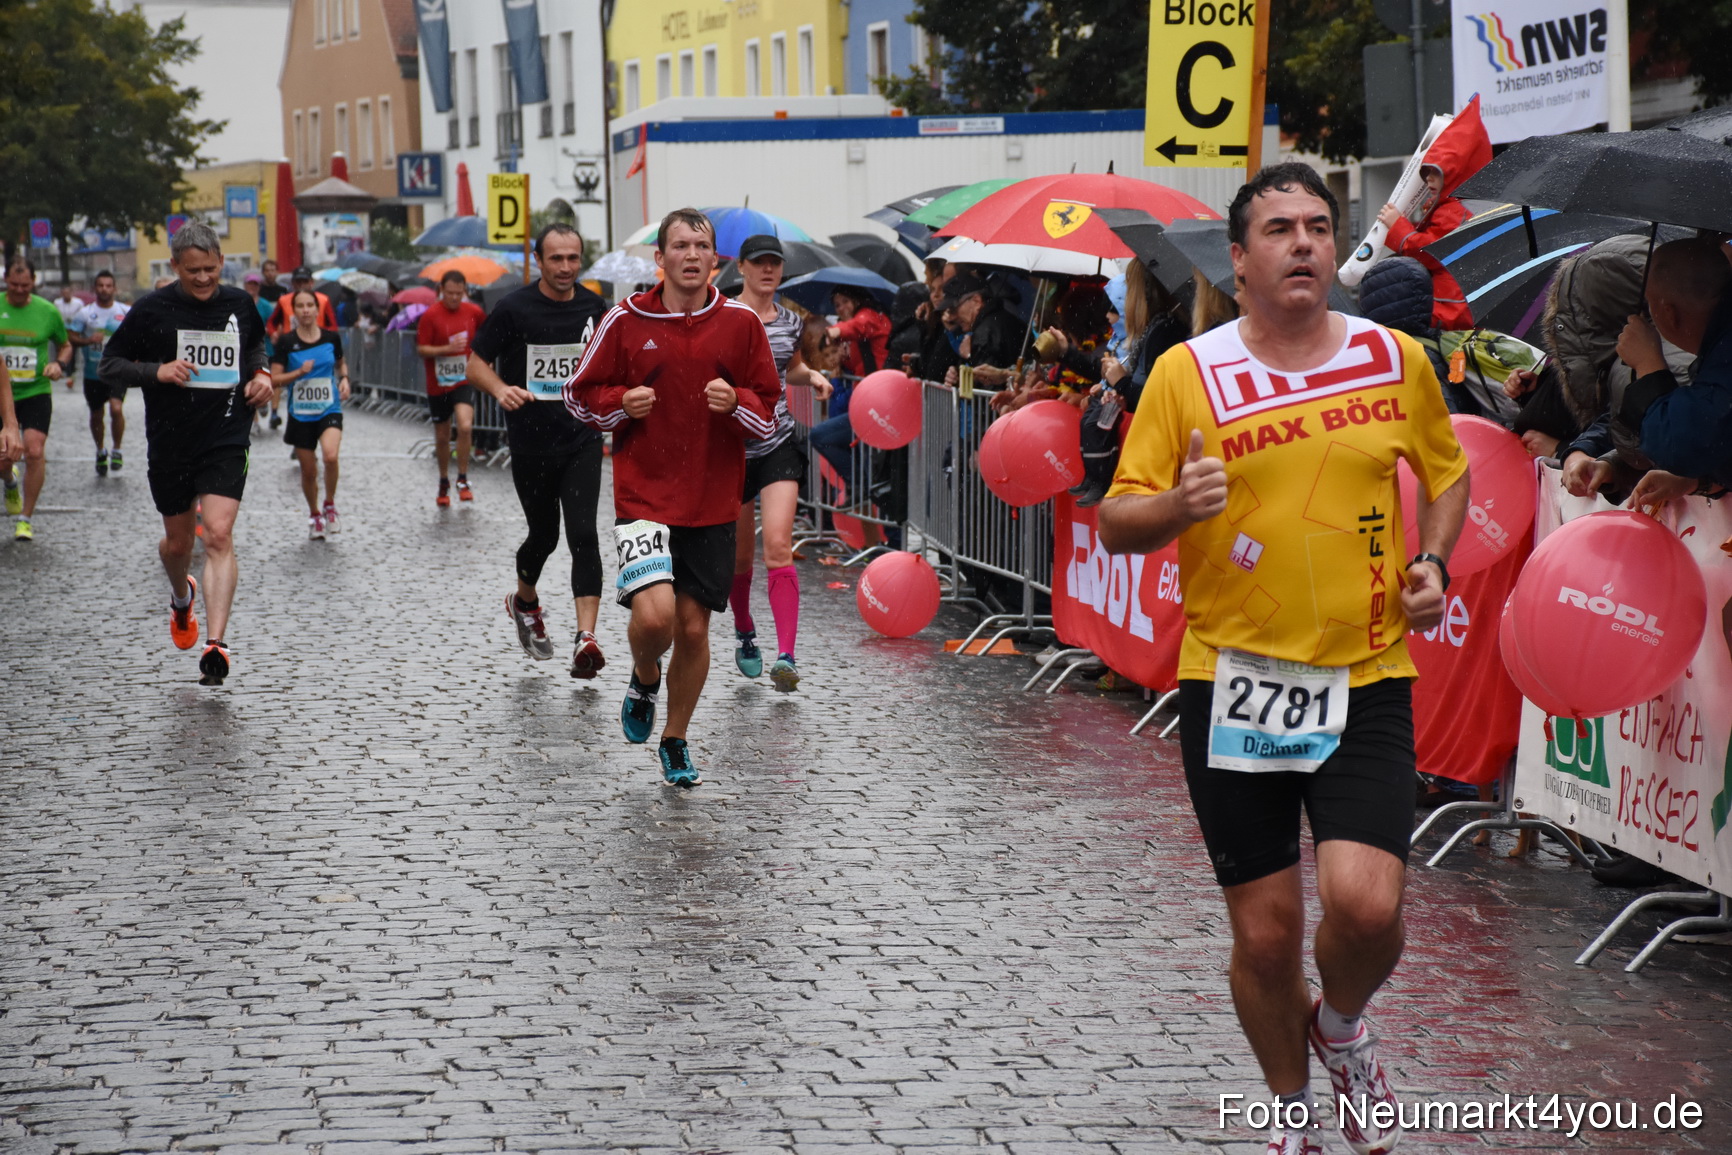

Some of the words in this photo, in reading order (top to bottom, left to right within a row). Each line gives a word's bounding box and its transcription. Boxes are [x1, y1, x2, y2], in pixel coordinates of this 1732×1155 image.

[1164, 0, 1254, 26] Block
[1176, 40, 1236, 129] C
[492, 175, 525, 189] Block
[499, 195, 518, 228] D
[183, 345, 235, 367] 3009
[438, 363, 465, 376] 2649
[297, 386, 330, 401] 2009
[542, 384, 563, 393] Andr
[1221, 416, 1312, 463] MAX
[1320, 397, 1407, 432] BÖGL
[622, 561, 666, 583] Alexander
[1611, 622, 1660, 647] energie
[1227, 676, 1330, 729] 2781
[1243, 735, 1311, 756] Dietmar
